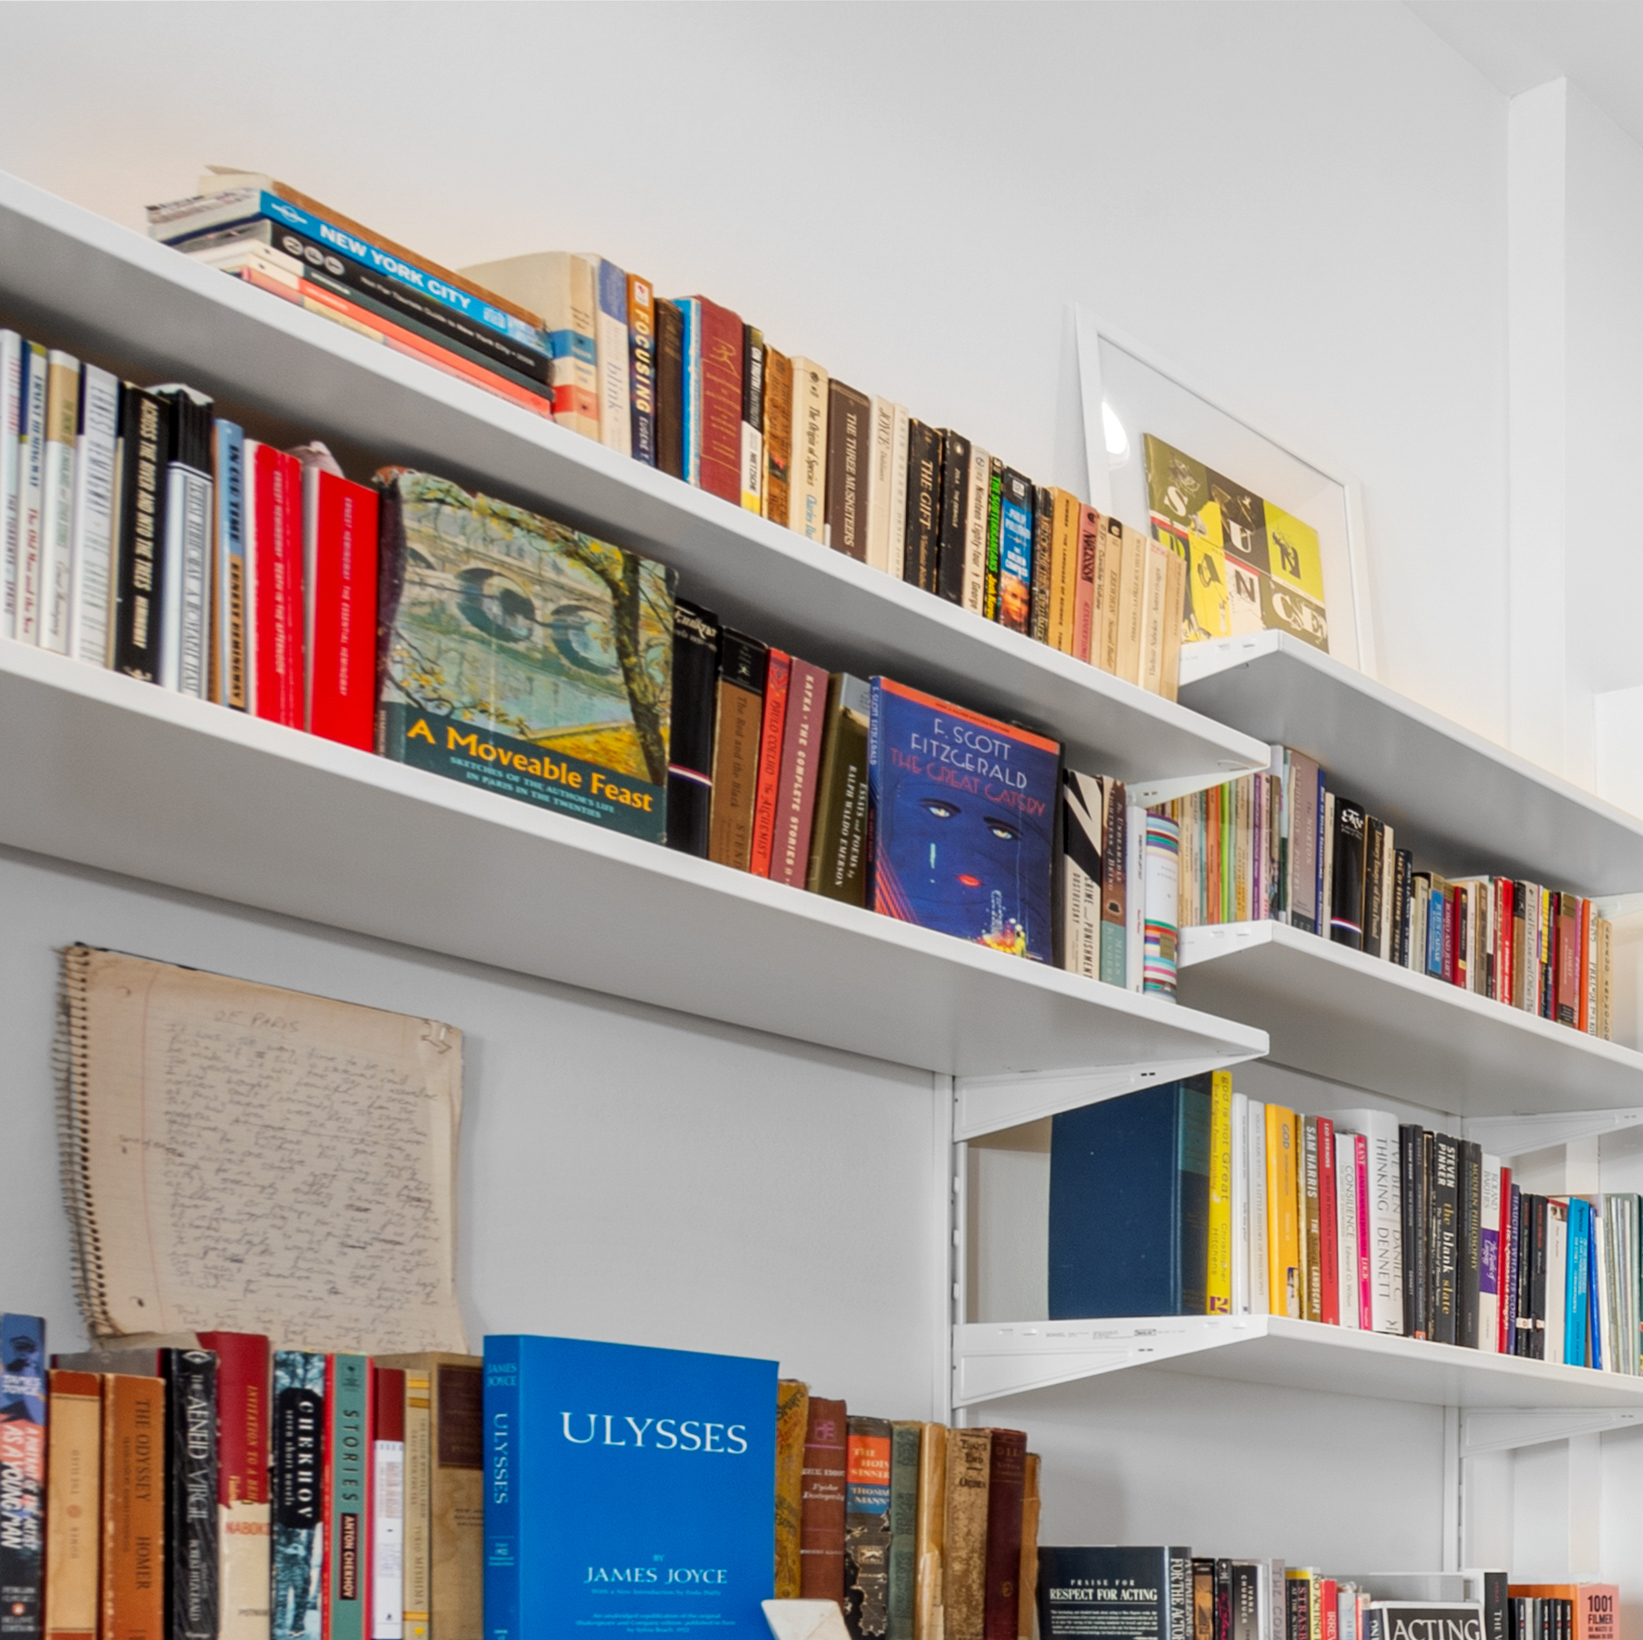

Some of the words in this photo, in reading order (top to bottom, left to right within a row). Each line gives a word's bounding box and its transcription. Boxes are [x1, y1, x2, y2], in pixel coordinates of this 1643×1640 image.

[320, 224, 365, 258] NEW
[372, 251, 423, 288] YORK
[428, 275, 472, 310] CITY
[635, 310, 651, 414] FOCUSING
[407, 719, 436, 744] A
[447, 726, 582, 788] Moveable
[590, 772, 653, 812] Feast
[911, 734, 1027, 789] FITZGERALD
[953, 726, 1011, 761] SCOTT
[890, 747, 921, 775] THE
[927, 762, 979, 794] GREAT
[984, 784, 1046, 817] GATSBY
[1306, 1126, 1315, 1151] SAM
[1307, 1153, 1317, 1198] HARRIS
[1376, 1138, 1389, 1211] THINKING
[1377, 1228, 1390, 1300] DENNETT
[135, 1399, 151, 1428] THE
[187, 1397, 210, 1460] AENEID
[560, 1412, 748, 1455] ULYSSES
[135, 1434, 150, 1502] ODYSSEY
[298, 1401, 314, 1519] CHEKHOV
[342, 1409, 360, 1503] STORIES
[493, 1413, 508, 1504] ULYSSES
[188, 1469, 209, 1522] VIRGIL
[136, 1536, 151, 1590] HOMER
[583, 1567, 658, 1584] JAMES
[665, 1567, 728, 1585] JOYCE
[1050, 1590, 1093, 1600] RESPECT
[1097, 1589, 1116, 1600] FOR
[1120, 1589, 1158, 1600] ACTING
[1588, 1596, 1613, 1612] 1001
[1588, 1614, 1612, 1624] FILMER
